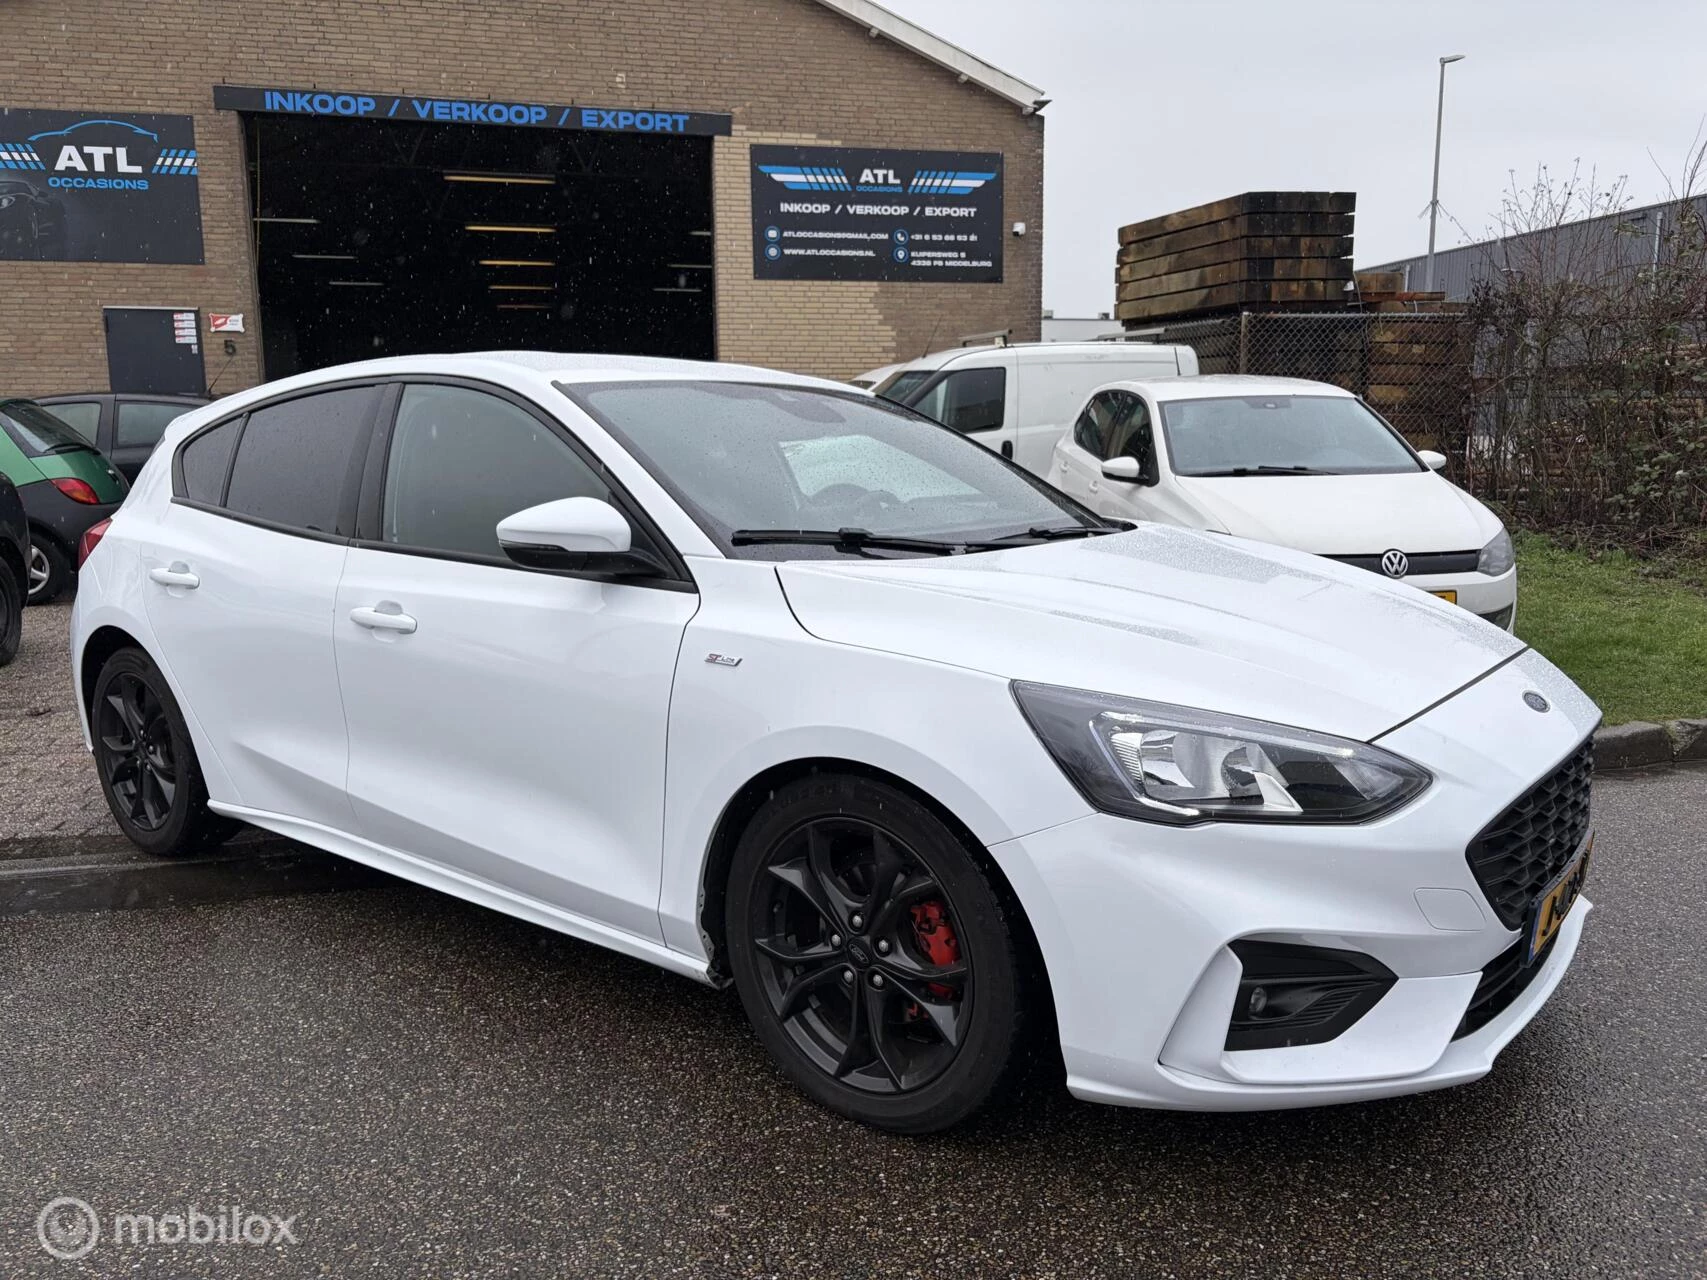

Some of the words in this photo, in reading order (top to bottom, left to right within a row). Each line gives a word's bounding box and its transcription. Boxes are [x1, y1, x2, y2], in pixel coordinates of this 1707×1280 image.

[264, 91, 376, 116] INKOOP
[388, 99, 400, 117] /
[412, 100, 547, 124] VERKOOP
[558, 108, 571, 125] /
[581, 111, 690, 132] EXPORT
[54, 145, 143, 174] ATL
[859, 168, 901, 184] ATL
[855, 185, 904, 193] OCCASIONS
[780, 202, 831, 214] INKOOP
[847, 205, 910, 216] VERKOOP
[924, 208, 977, 218] EXPORT
[224, 339, 237, 355] 5
